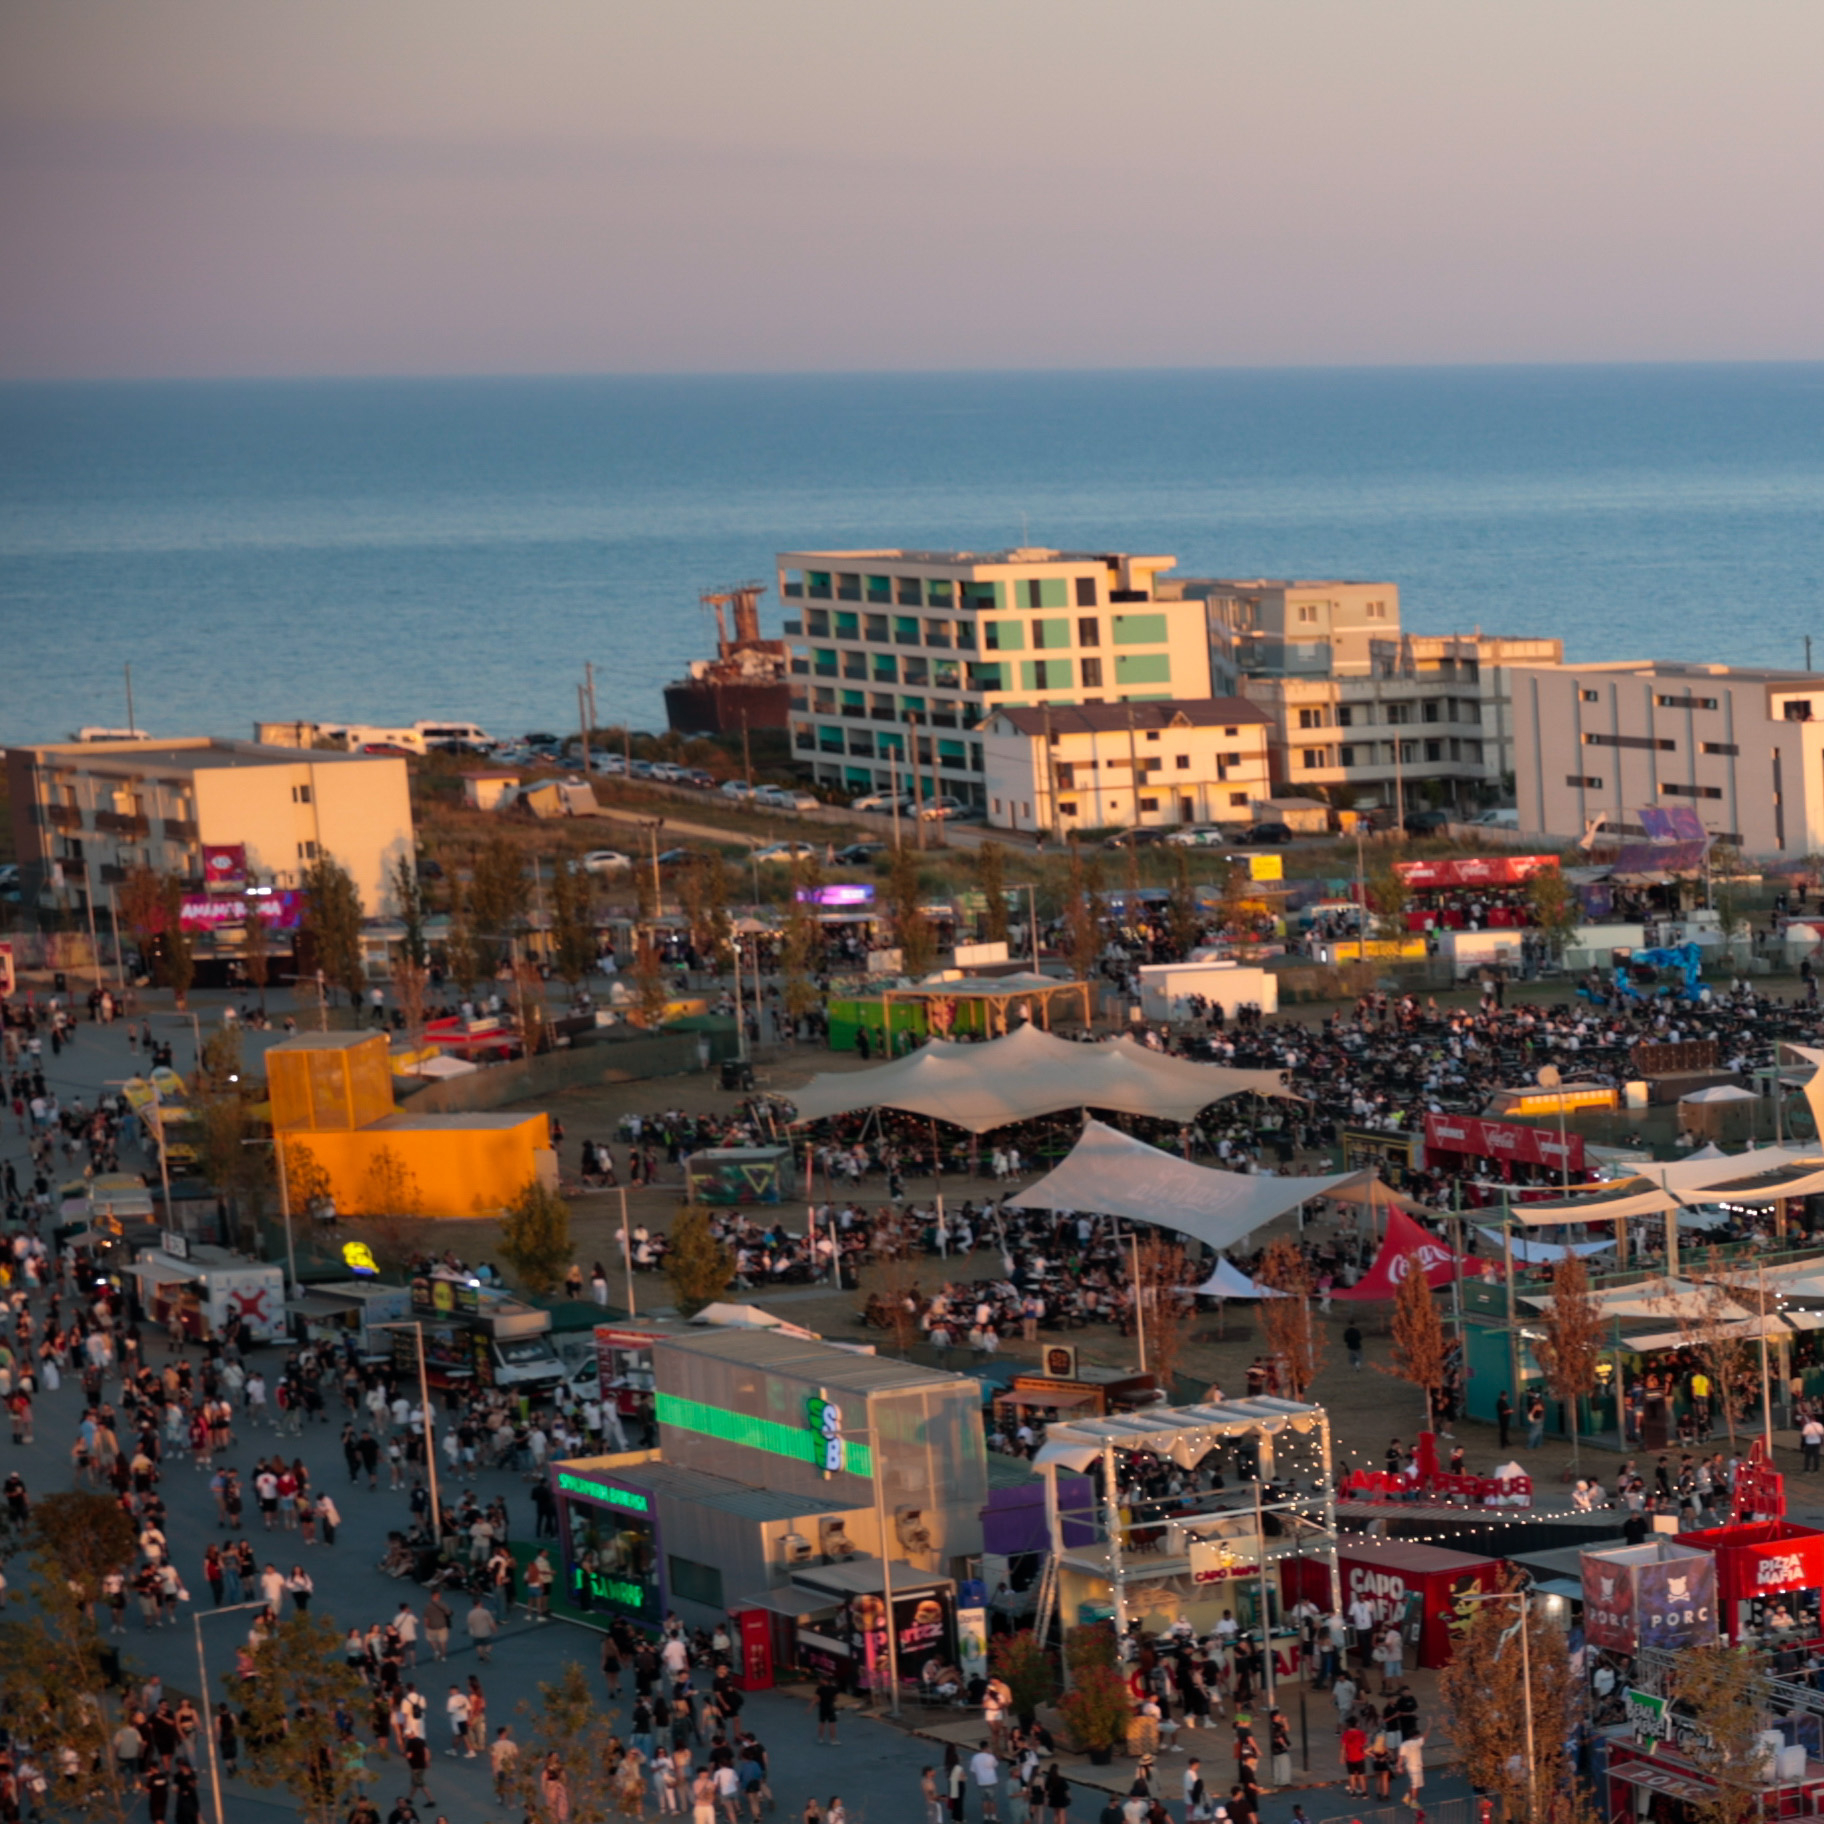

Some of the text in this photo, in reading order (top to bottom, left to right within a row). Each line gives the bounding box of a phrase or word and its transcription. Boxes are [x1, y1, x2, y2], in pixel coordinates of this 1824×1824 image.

[1758, 1554, 1801, 1574] PIZZA
[1349, 1567, 1406, 1601] CAPO
[1757, 1568, 1804, 1585] MAFIA
[1349, 1591, 1407, 1625] AFIA
[1589, 1608, 1630, 1630] PORC
[1650, 1606, 1710, 1629] PORC
